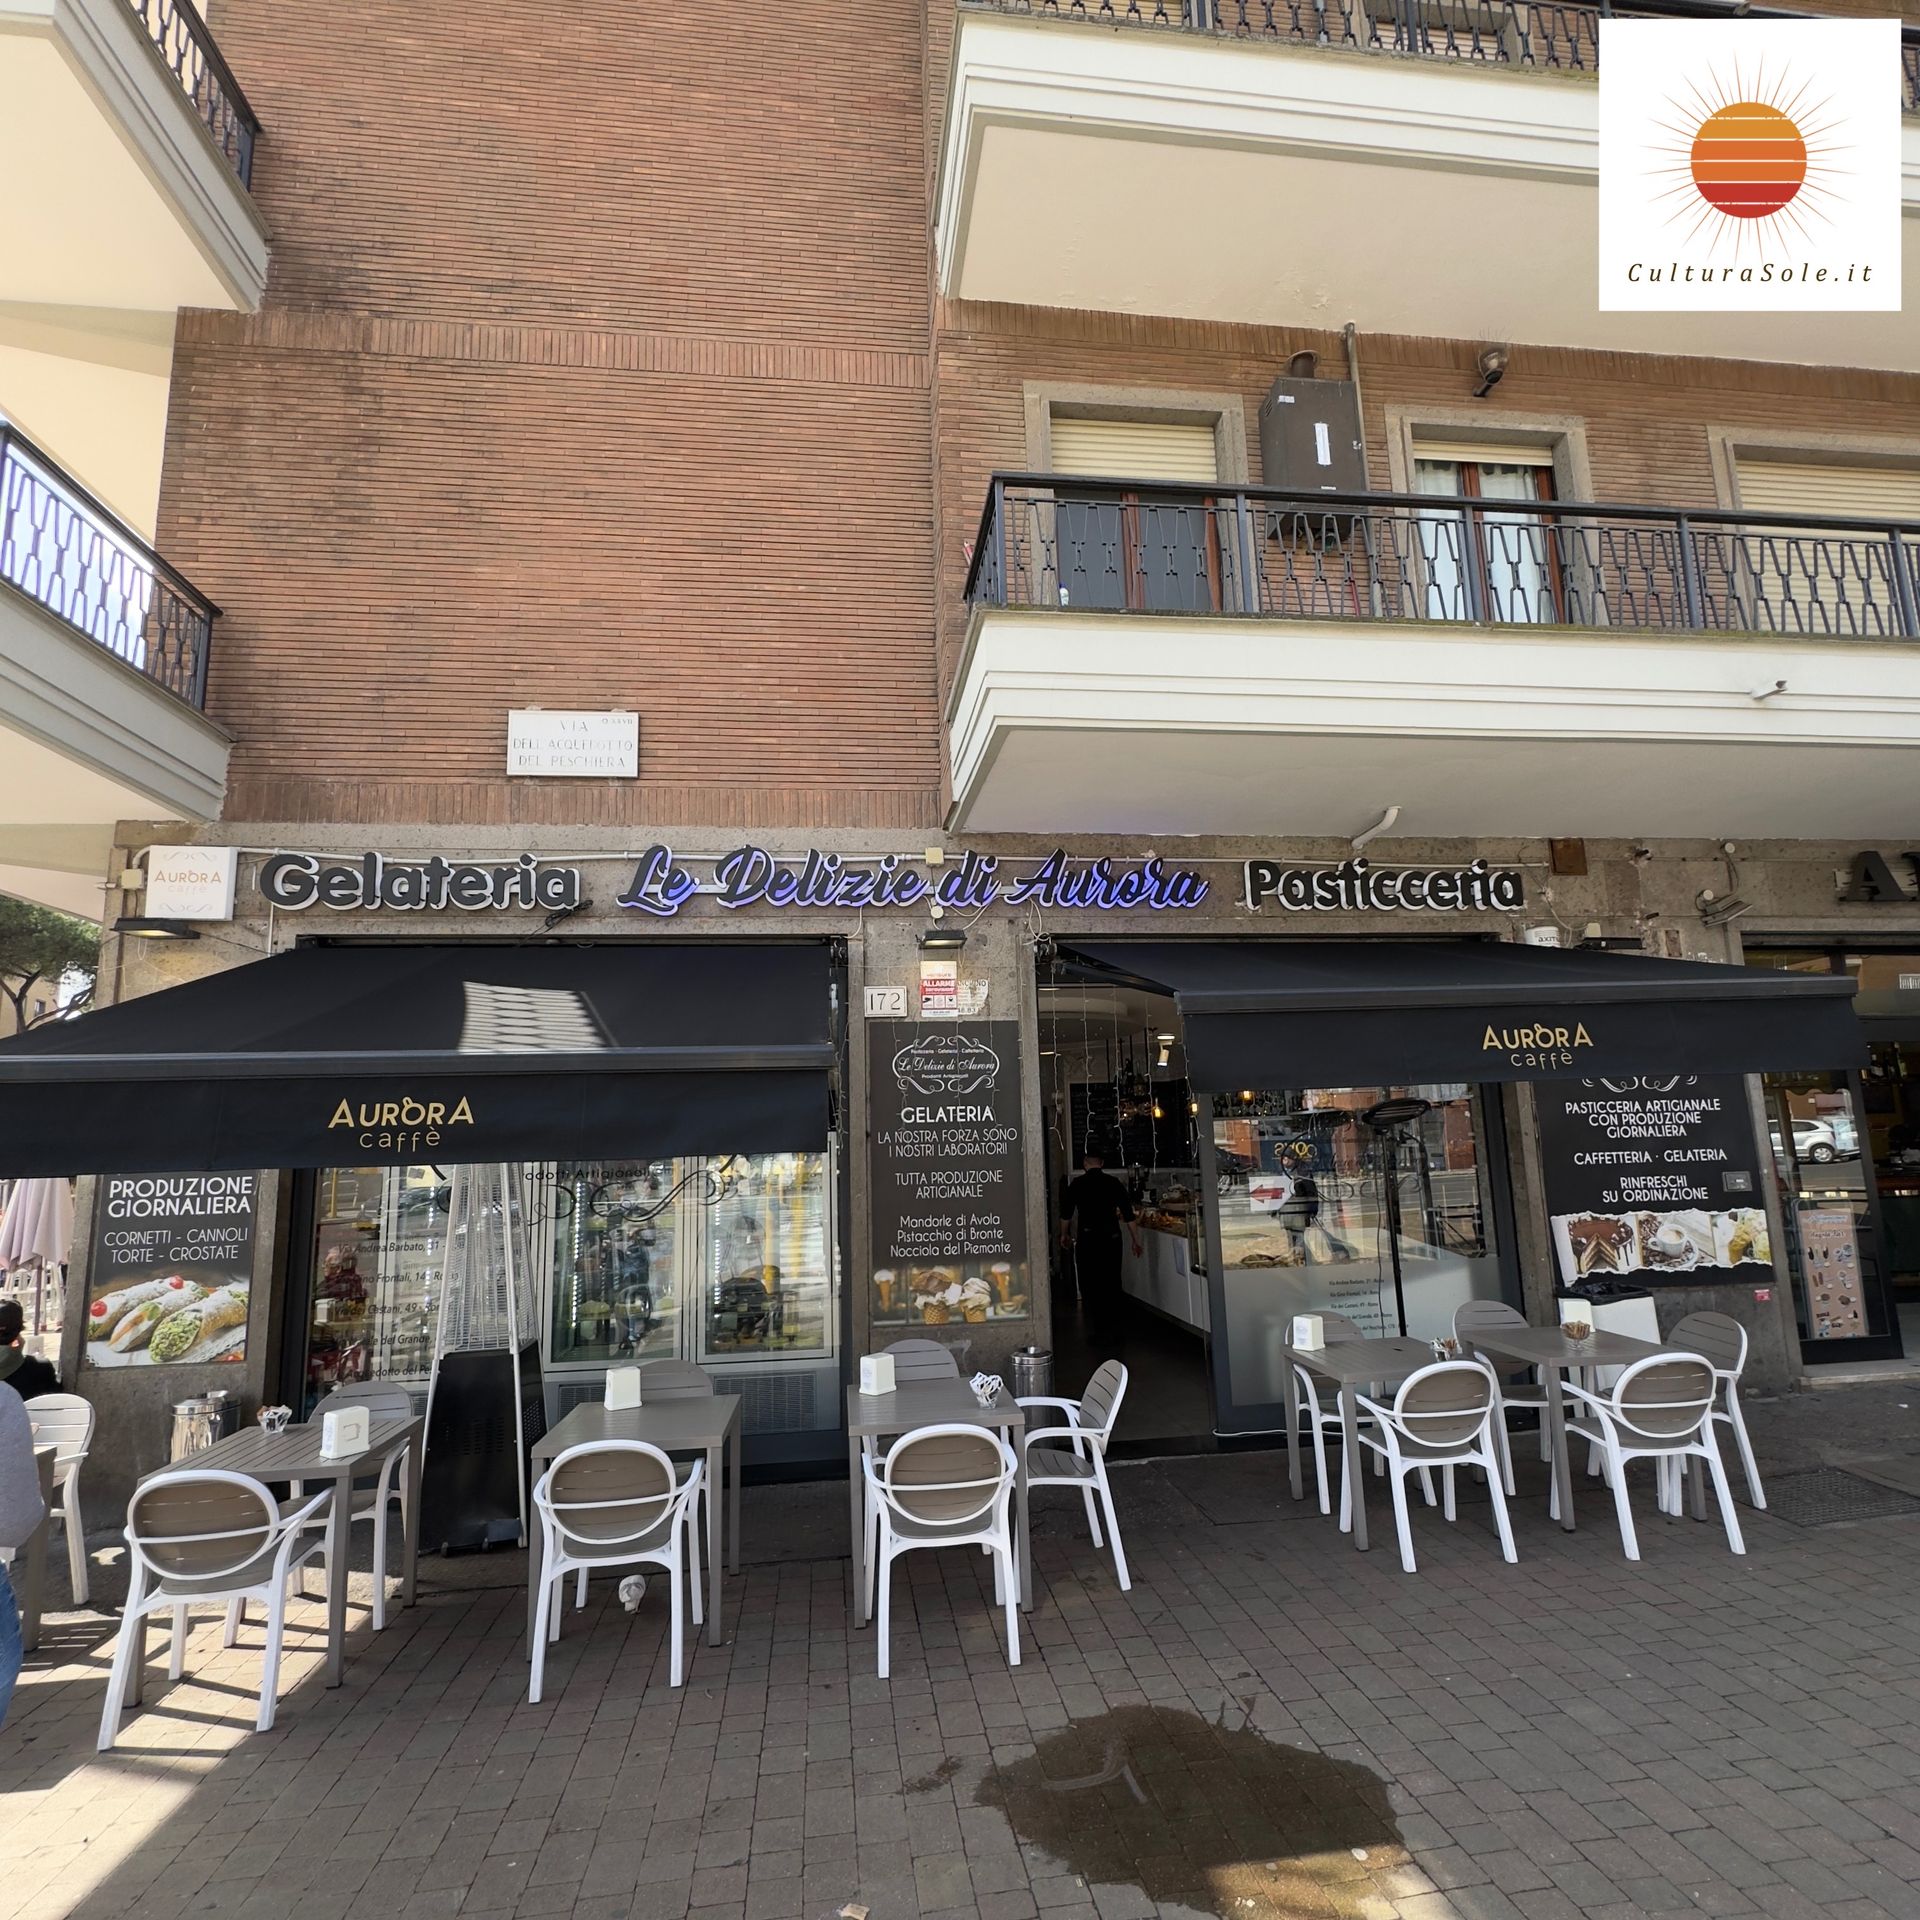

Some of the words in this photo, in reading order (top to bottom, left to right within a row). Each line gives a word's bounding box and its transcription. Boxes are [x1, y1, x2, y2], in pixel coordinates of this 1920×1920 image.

[560, 721, 588, 732] VIA
[259, 851, 581, 910] Gelateria
[616, 844, 700, 917] Le
[714, 844, 931, 910] Delizie
[936, 849, 1001, 907] di
[1001, 848, 1210, 910] Aurora
[1243, 857, 1525, 911] Pasticceria
[870, 992, 901, 1011] 172
[1483, 1022, 1594, 1050] AURORA
[898, 1057, 911, 1071] Le
[914, 1057, 945, 1071] Delizie
[946, 1059, 955, 1070] di
[959, 1057, 995, 1070] Aurora
[1510, 1048, 1573, 1071] caffè
[328, 1096, 474, 1128] AURORA
[901, 1105, 994, 1123] GELATERIA
[1565, 1101, 1641, 1114] PASTICCERIA
[1645, 1099, 1721, 1112] ARTIGIANALE
[1589, 1114, 1618, 1126] CON
[1622, 1112, 1701, 1126] PRODUZIONE
[878, 1131, 891, 1143] LA
[895, 1130, 938, 1143] NOSTRA
[942, 1129, 979, 1142] FORZA
[983, 1128, 1017, 1141] SONO
[1607, 1124, 1687, 1138] GIORNALIERA
[359, 1126, 441, 1153] caffè
[895, 1144, 935, 1157] NOSTRI
[1574, 1151, 1652, 1165] CAFFETTERIA
[1663, 1149, 1727, 1162] GELATERIA
[895, 1172, 927, 1185] TUTTA
[931, 1170, 1003, 1184] PRODUZIONE
[1620, 1175, 1688, 1189] RINFRESCHI
[109, 1176, 253, 1198] PRODUZIONE
[916, 1185, 983, 1199] ARTIGIANALE
[1602, 1190, 1619, 1203] SU
[1623, 1187, 1709, 1202] ORDINAZIONE
[108, 1195, 251, 1218] GIORNALIERA
[900, 1214, 952, 1228] Mandorle
[956, 1213, 966, 1226] di
[970, 1212, 1000, 1226] Avola
[104, 1230, 171, 1246] CORNETTI
[187, 1227, 248, 1243] CANNOLI
[897, 1229, 953, 1243] Pistacchio
[956, 1228, 967, 1240] di
[970, 1227, 1004, 1240] Bronte
[112, 1248, 153, 1263] TORTE
[169, 1245, 238, 1261] CROSTATE
[353, 1243, 387, 1253] Andrea
[389, 1242, 426, 1252] Barbato,
[890, 1244, 940, 1258] Nocciola
[943, 1242, 960, 1255] del
[964, 1242, 1012, 1255] Piemonte
[402, 1365, 417, 1376] del
